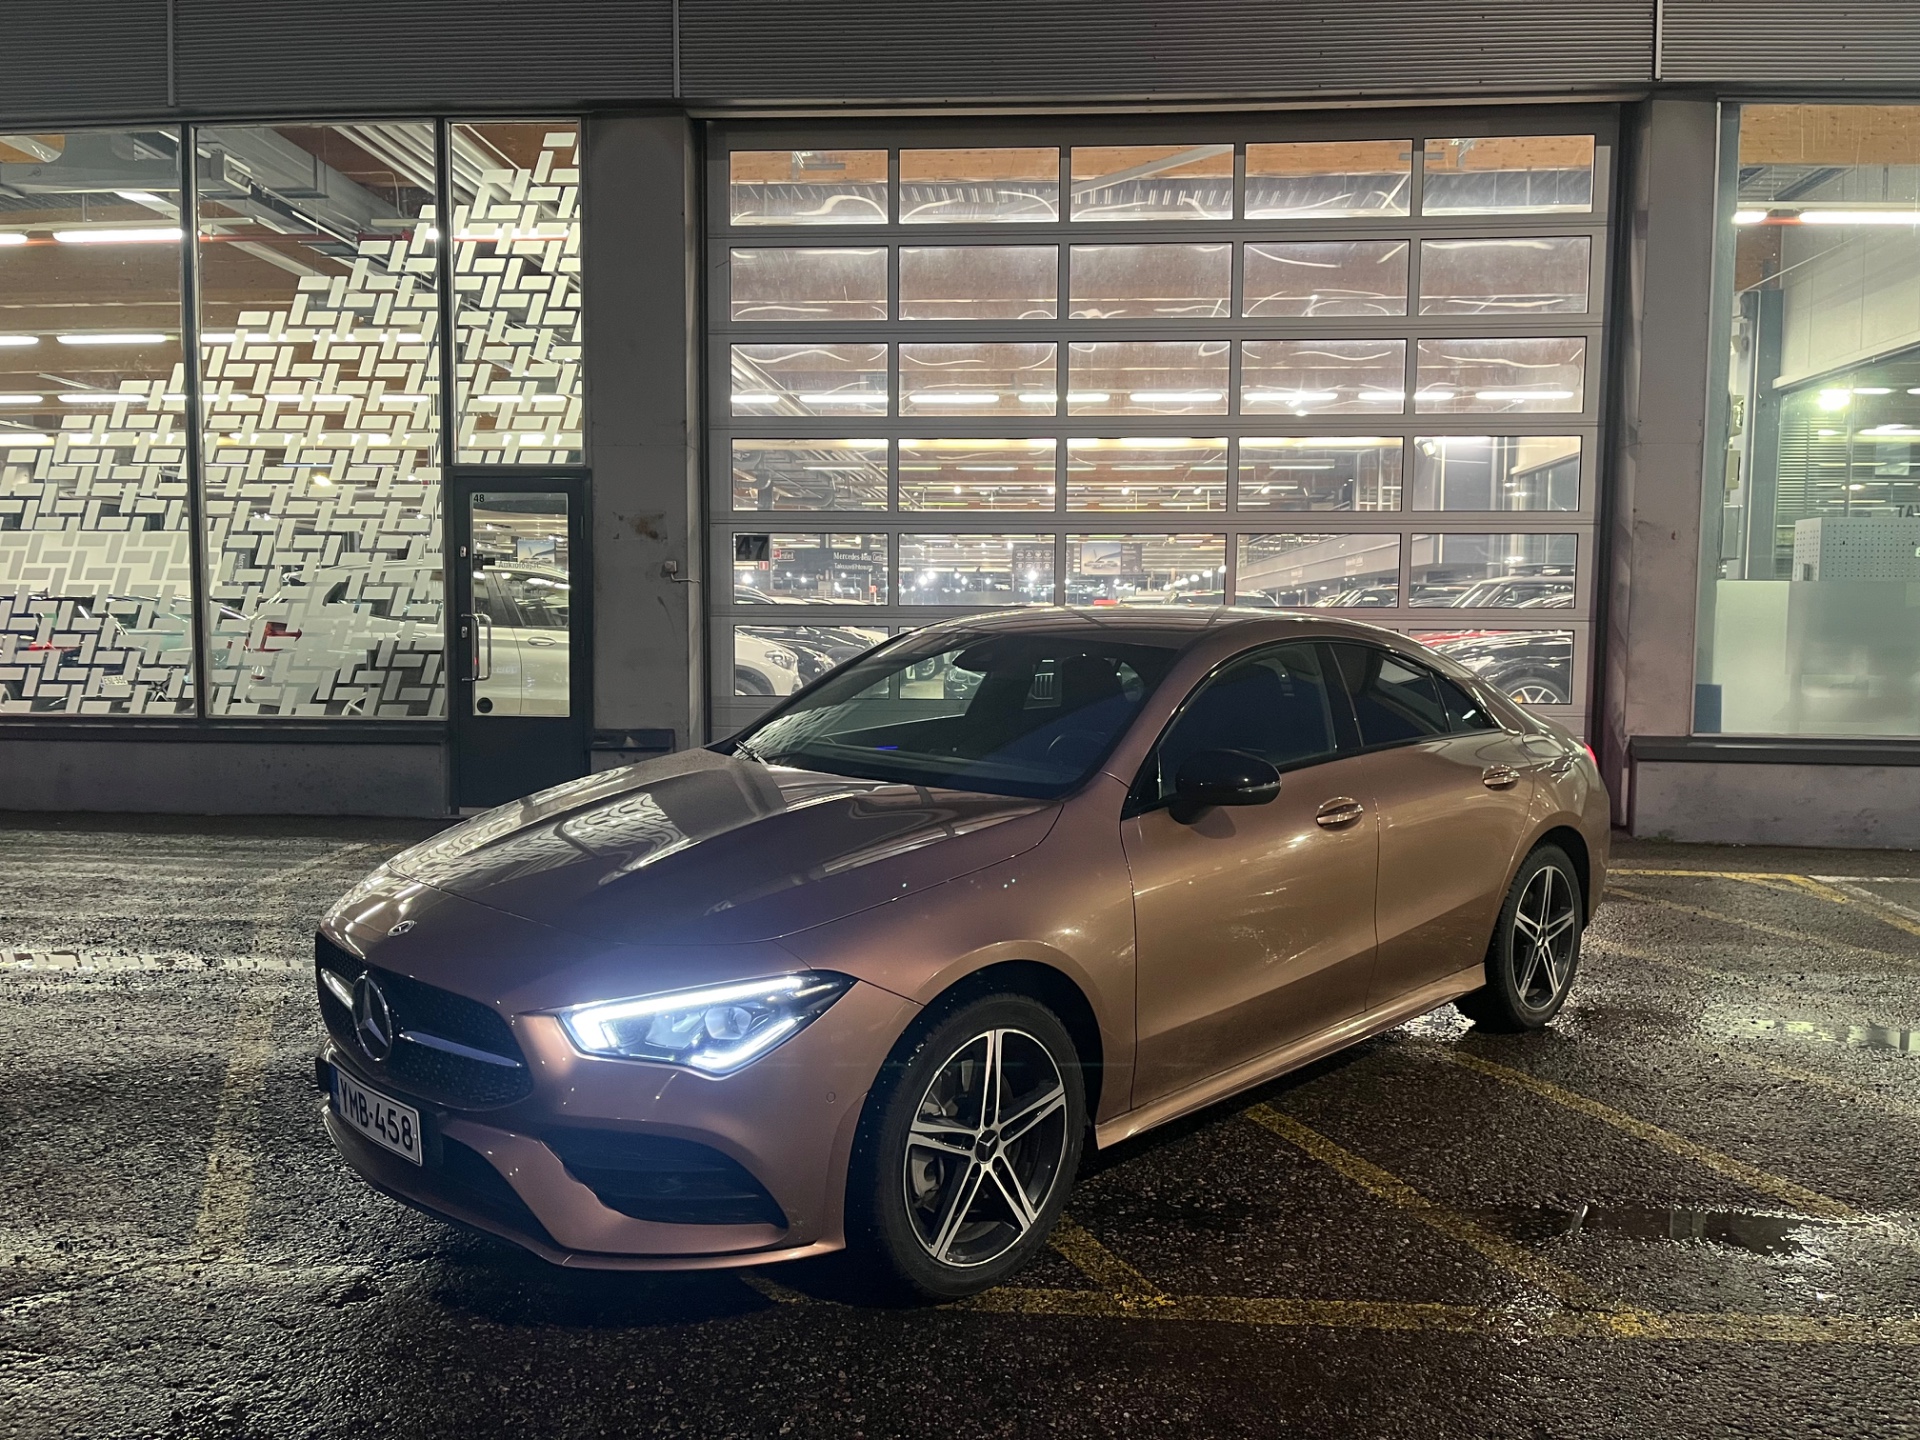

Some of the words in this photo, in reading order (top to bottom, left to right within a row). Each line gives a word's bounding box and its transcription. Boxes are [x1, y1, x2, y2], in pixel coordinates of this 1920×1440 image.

[473, 493, 485, 503] 48
[737, 536, 769, 560] 47
[340, 1077, 414, 1153] YMB-458
